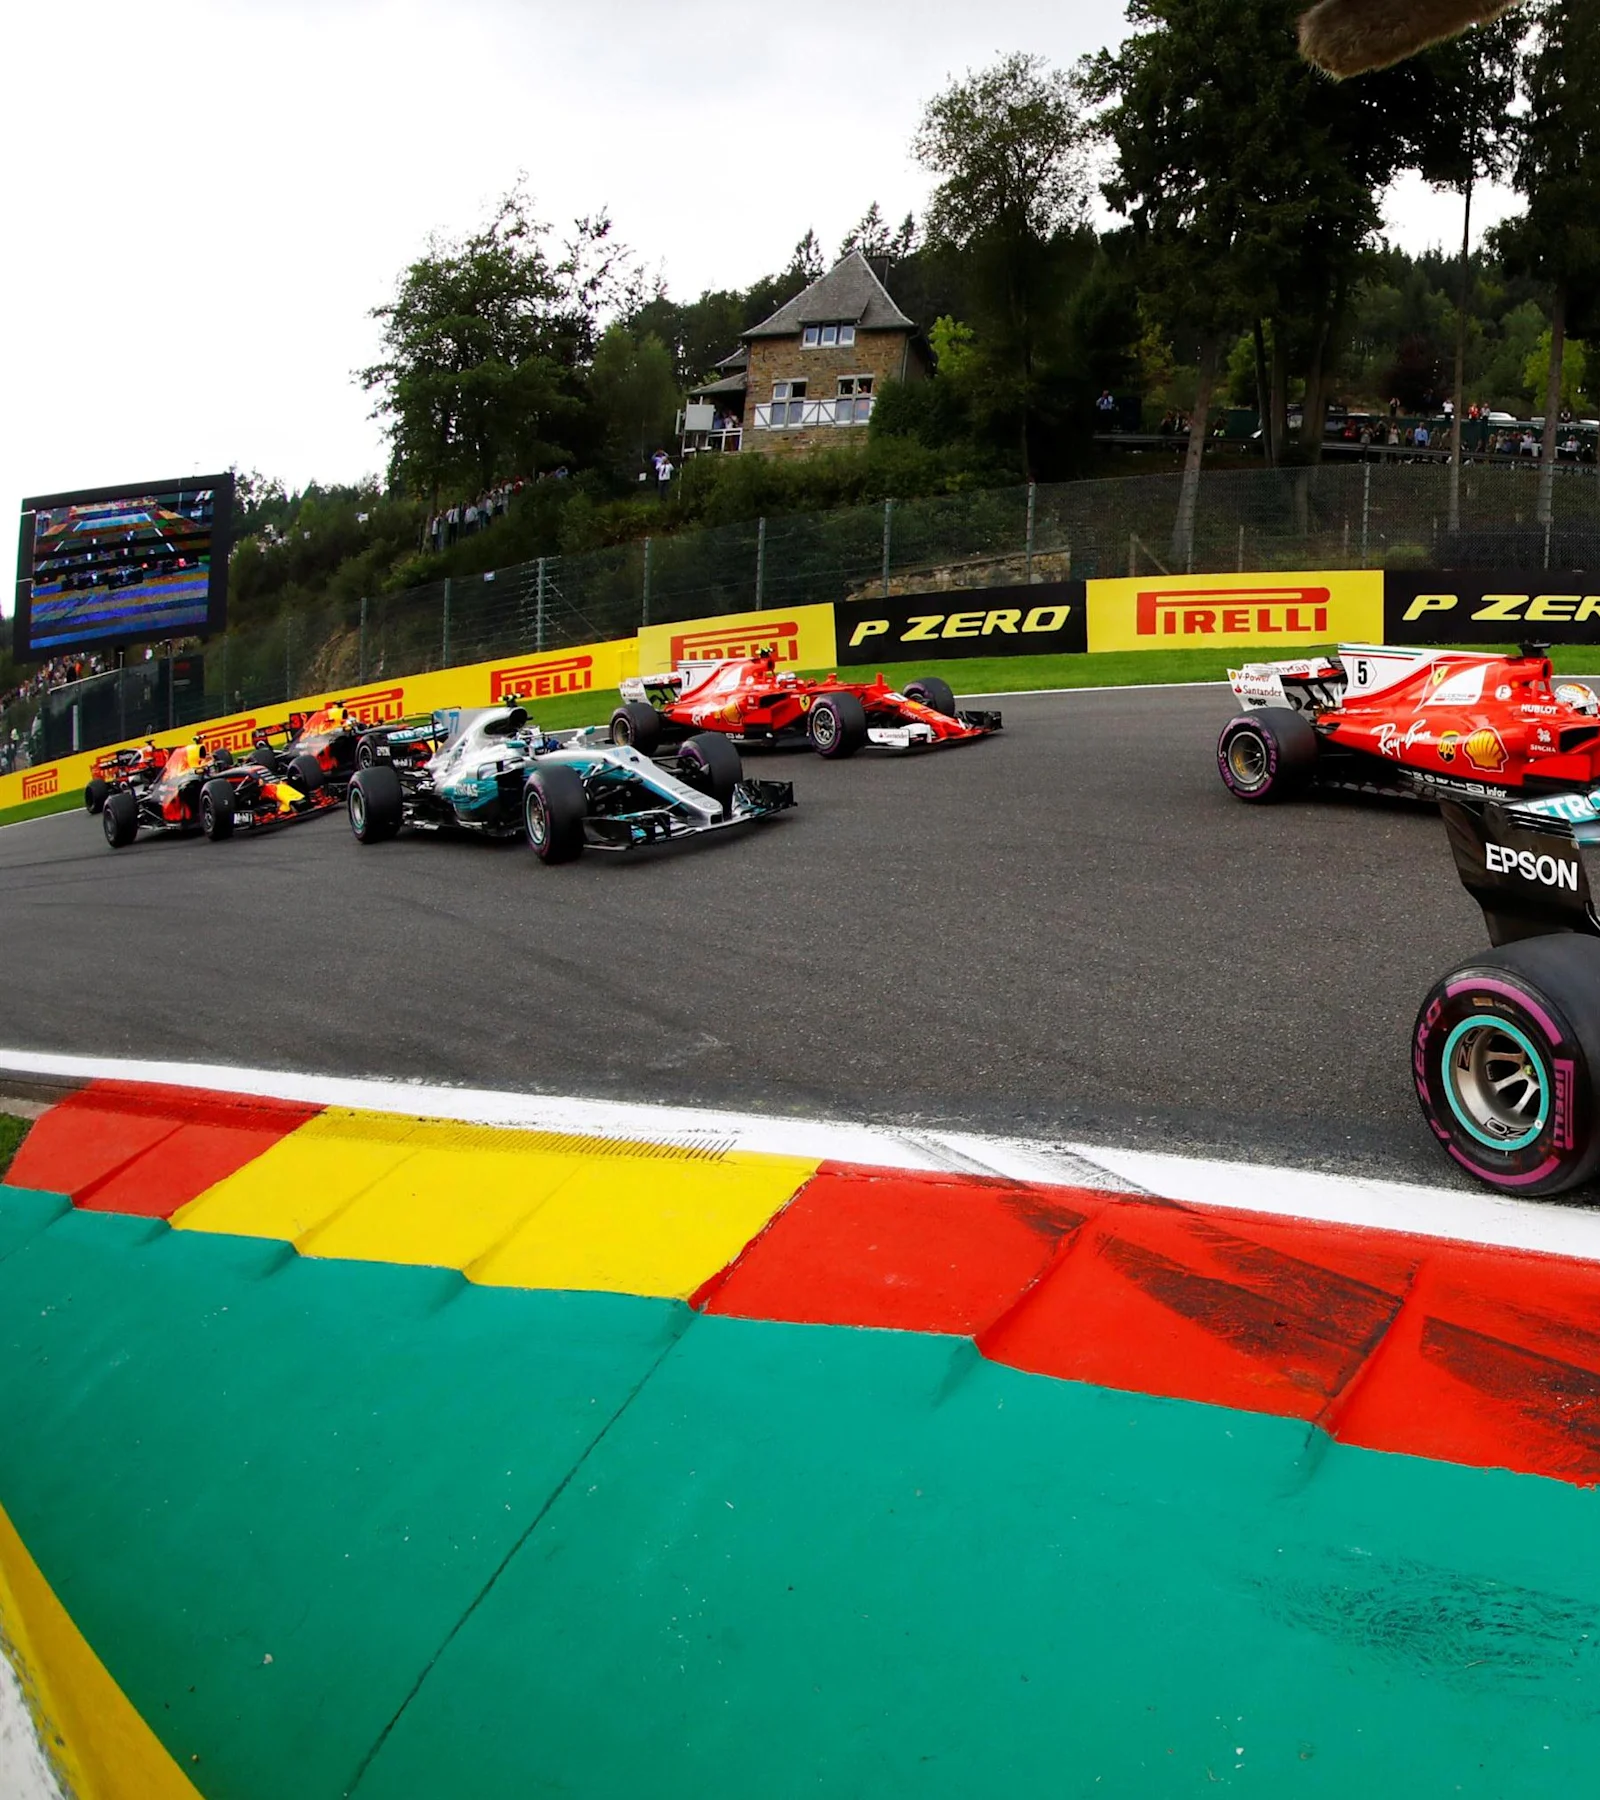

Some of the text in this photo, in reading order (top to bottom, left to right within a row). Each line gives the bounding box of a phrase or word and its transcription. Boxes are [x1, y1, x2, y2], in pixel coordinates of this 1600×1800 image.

[1137, 587, 1331, 635] PIRELLI
[1402, 594, 1458, 621] P
[849, 605, 1071, 647] P ZERO
[490, 655, 593, 704] PIRELLI
[1237, 674, 1271, 683] V-Power
[1357, 660, 1368, 685] 5
[1242, 685, 1282, 697] Santander
[1521, 704, 1558, 715] HUBLOT
[1438, 740, 1456, 760] ups
[1530, 743, 1556, 753] SINGHA
[23, 768, 58, 800] PIRELLI
[1486, 786, 1507, 798] infor
[1485, 842, 1578, 892] EPSON
[1413, 997, 1442, 1106] ZERO
[1552, 1058, 1575, 1150] PIRELLI
